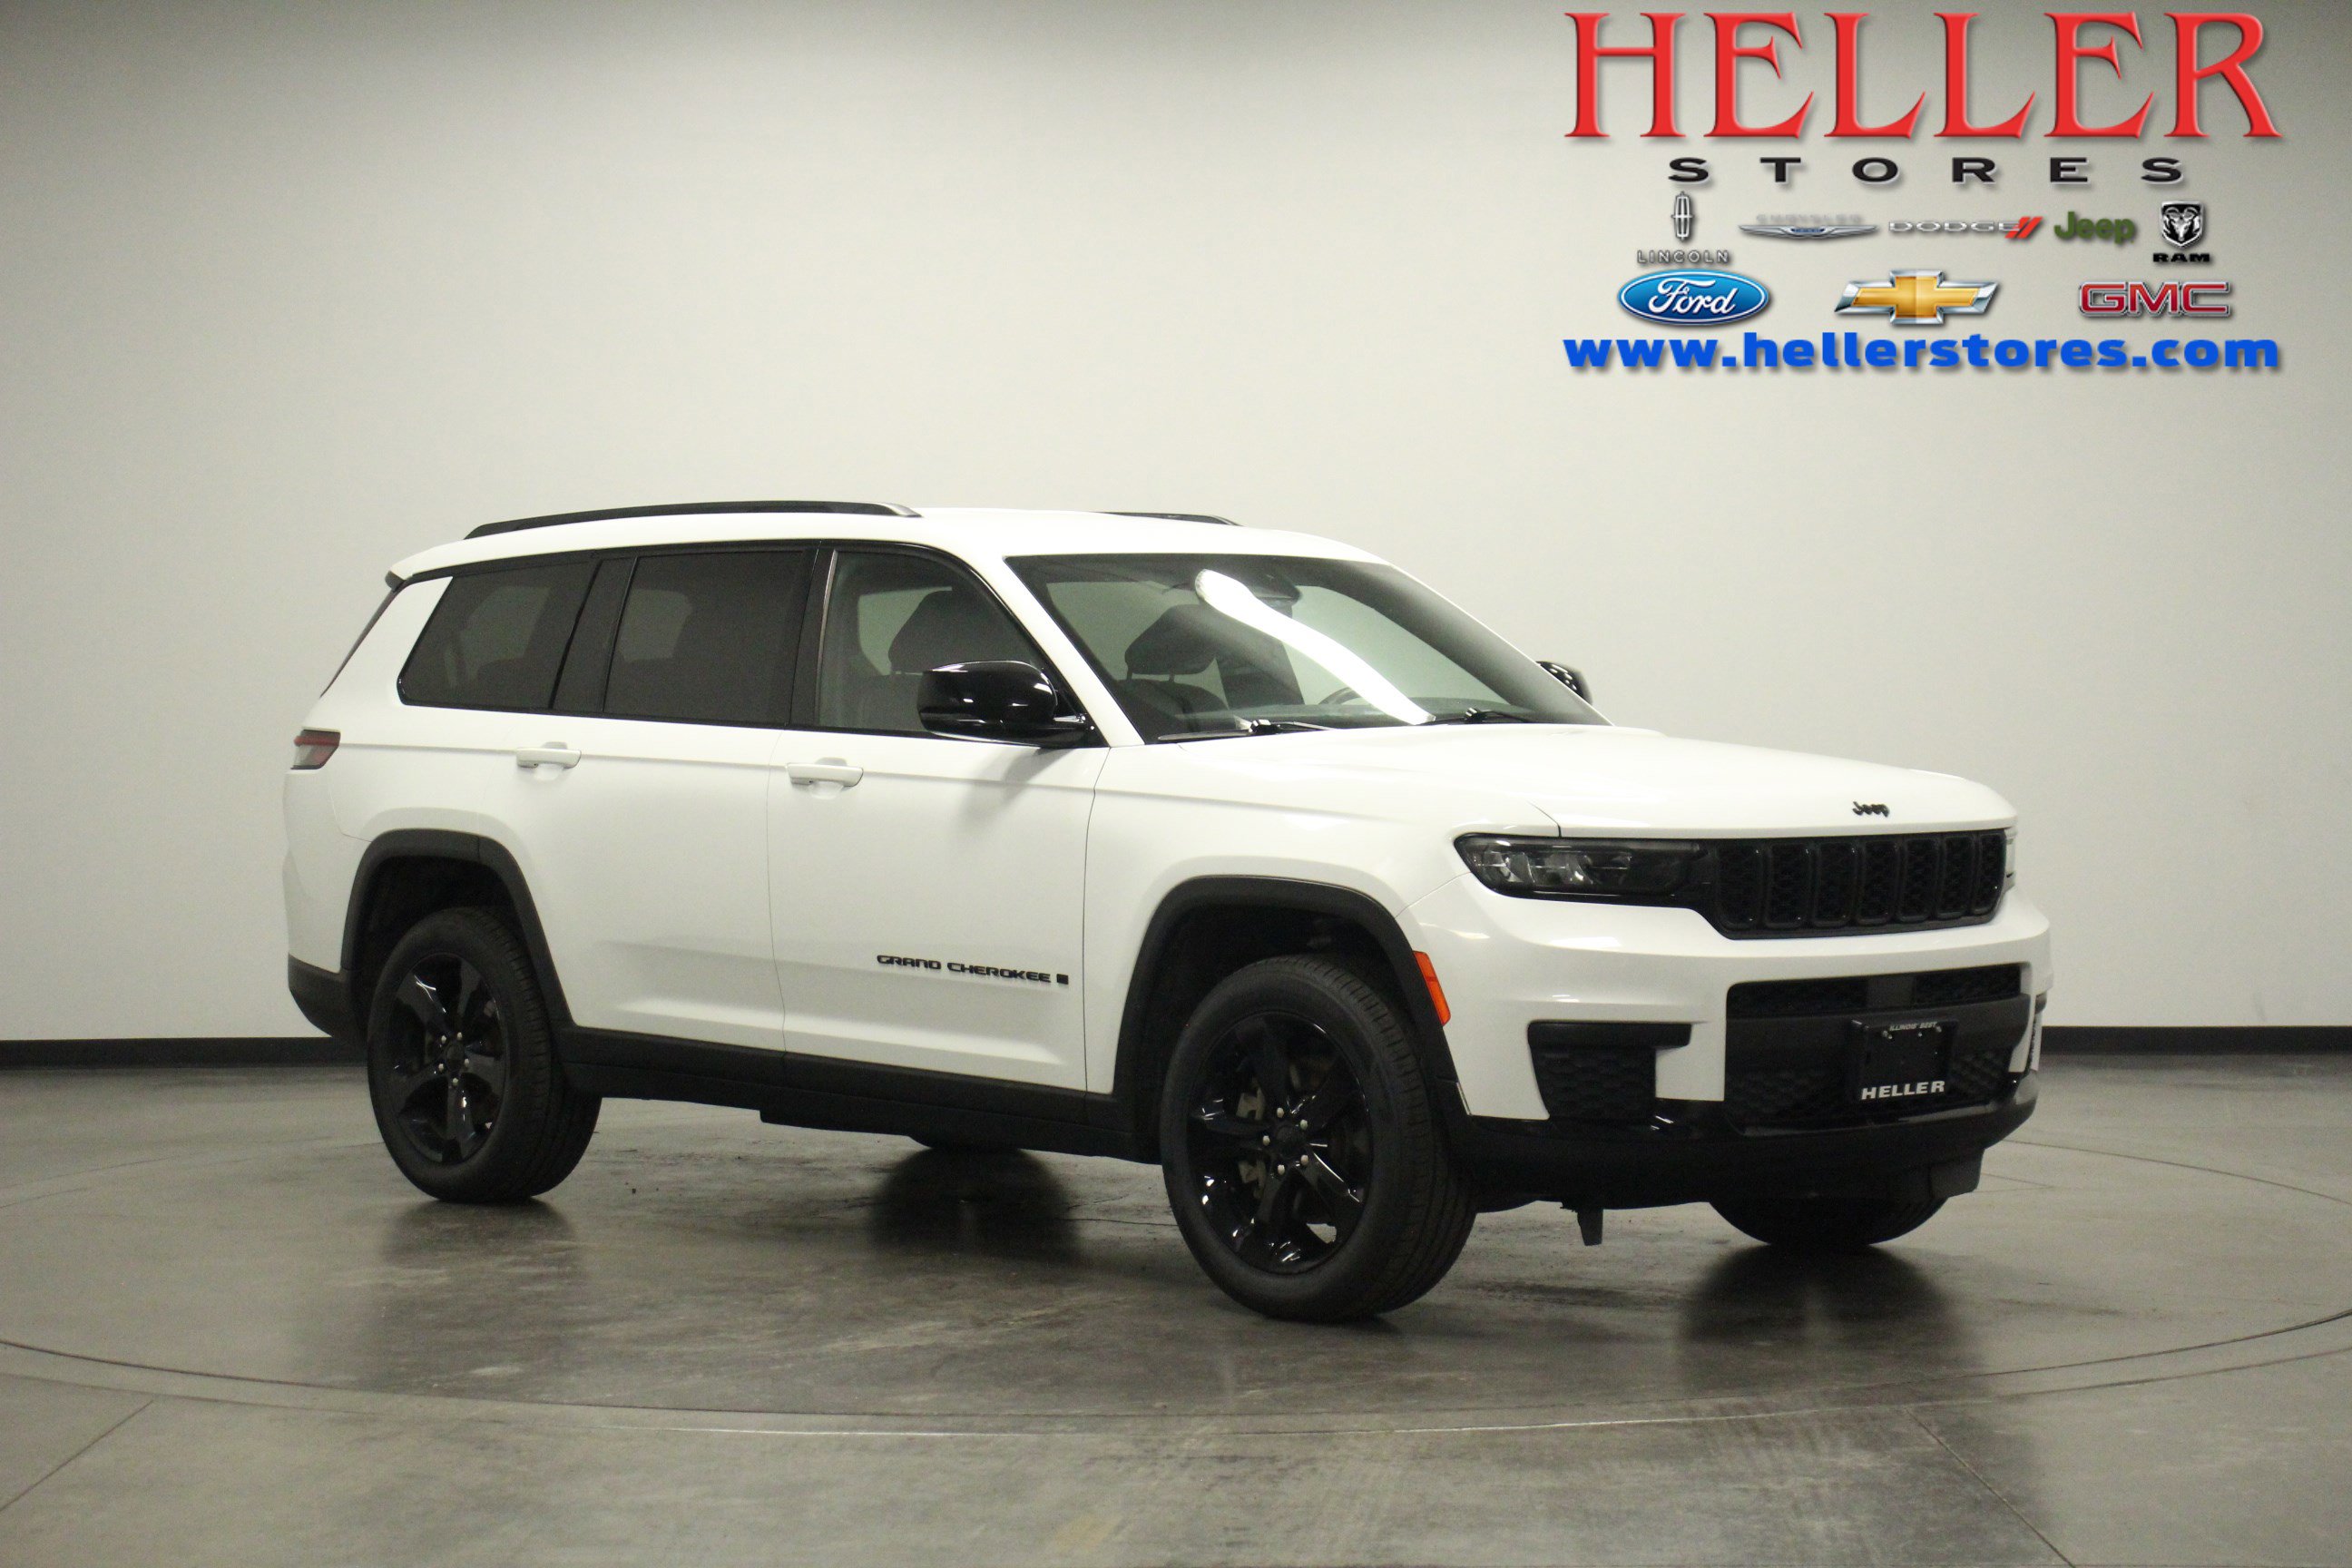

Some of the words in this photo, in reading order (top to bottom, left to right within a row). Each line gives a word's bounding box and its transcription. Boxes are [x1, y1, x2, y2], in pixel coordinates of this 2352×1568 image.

[877, 955, 942, 971] GRAND
[946, 962, 1052, 984] CHEROKEE
[1861, 1080, 1945, 1101] HELLER
